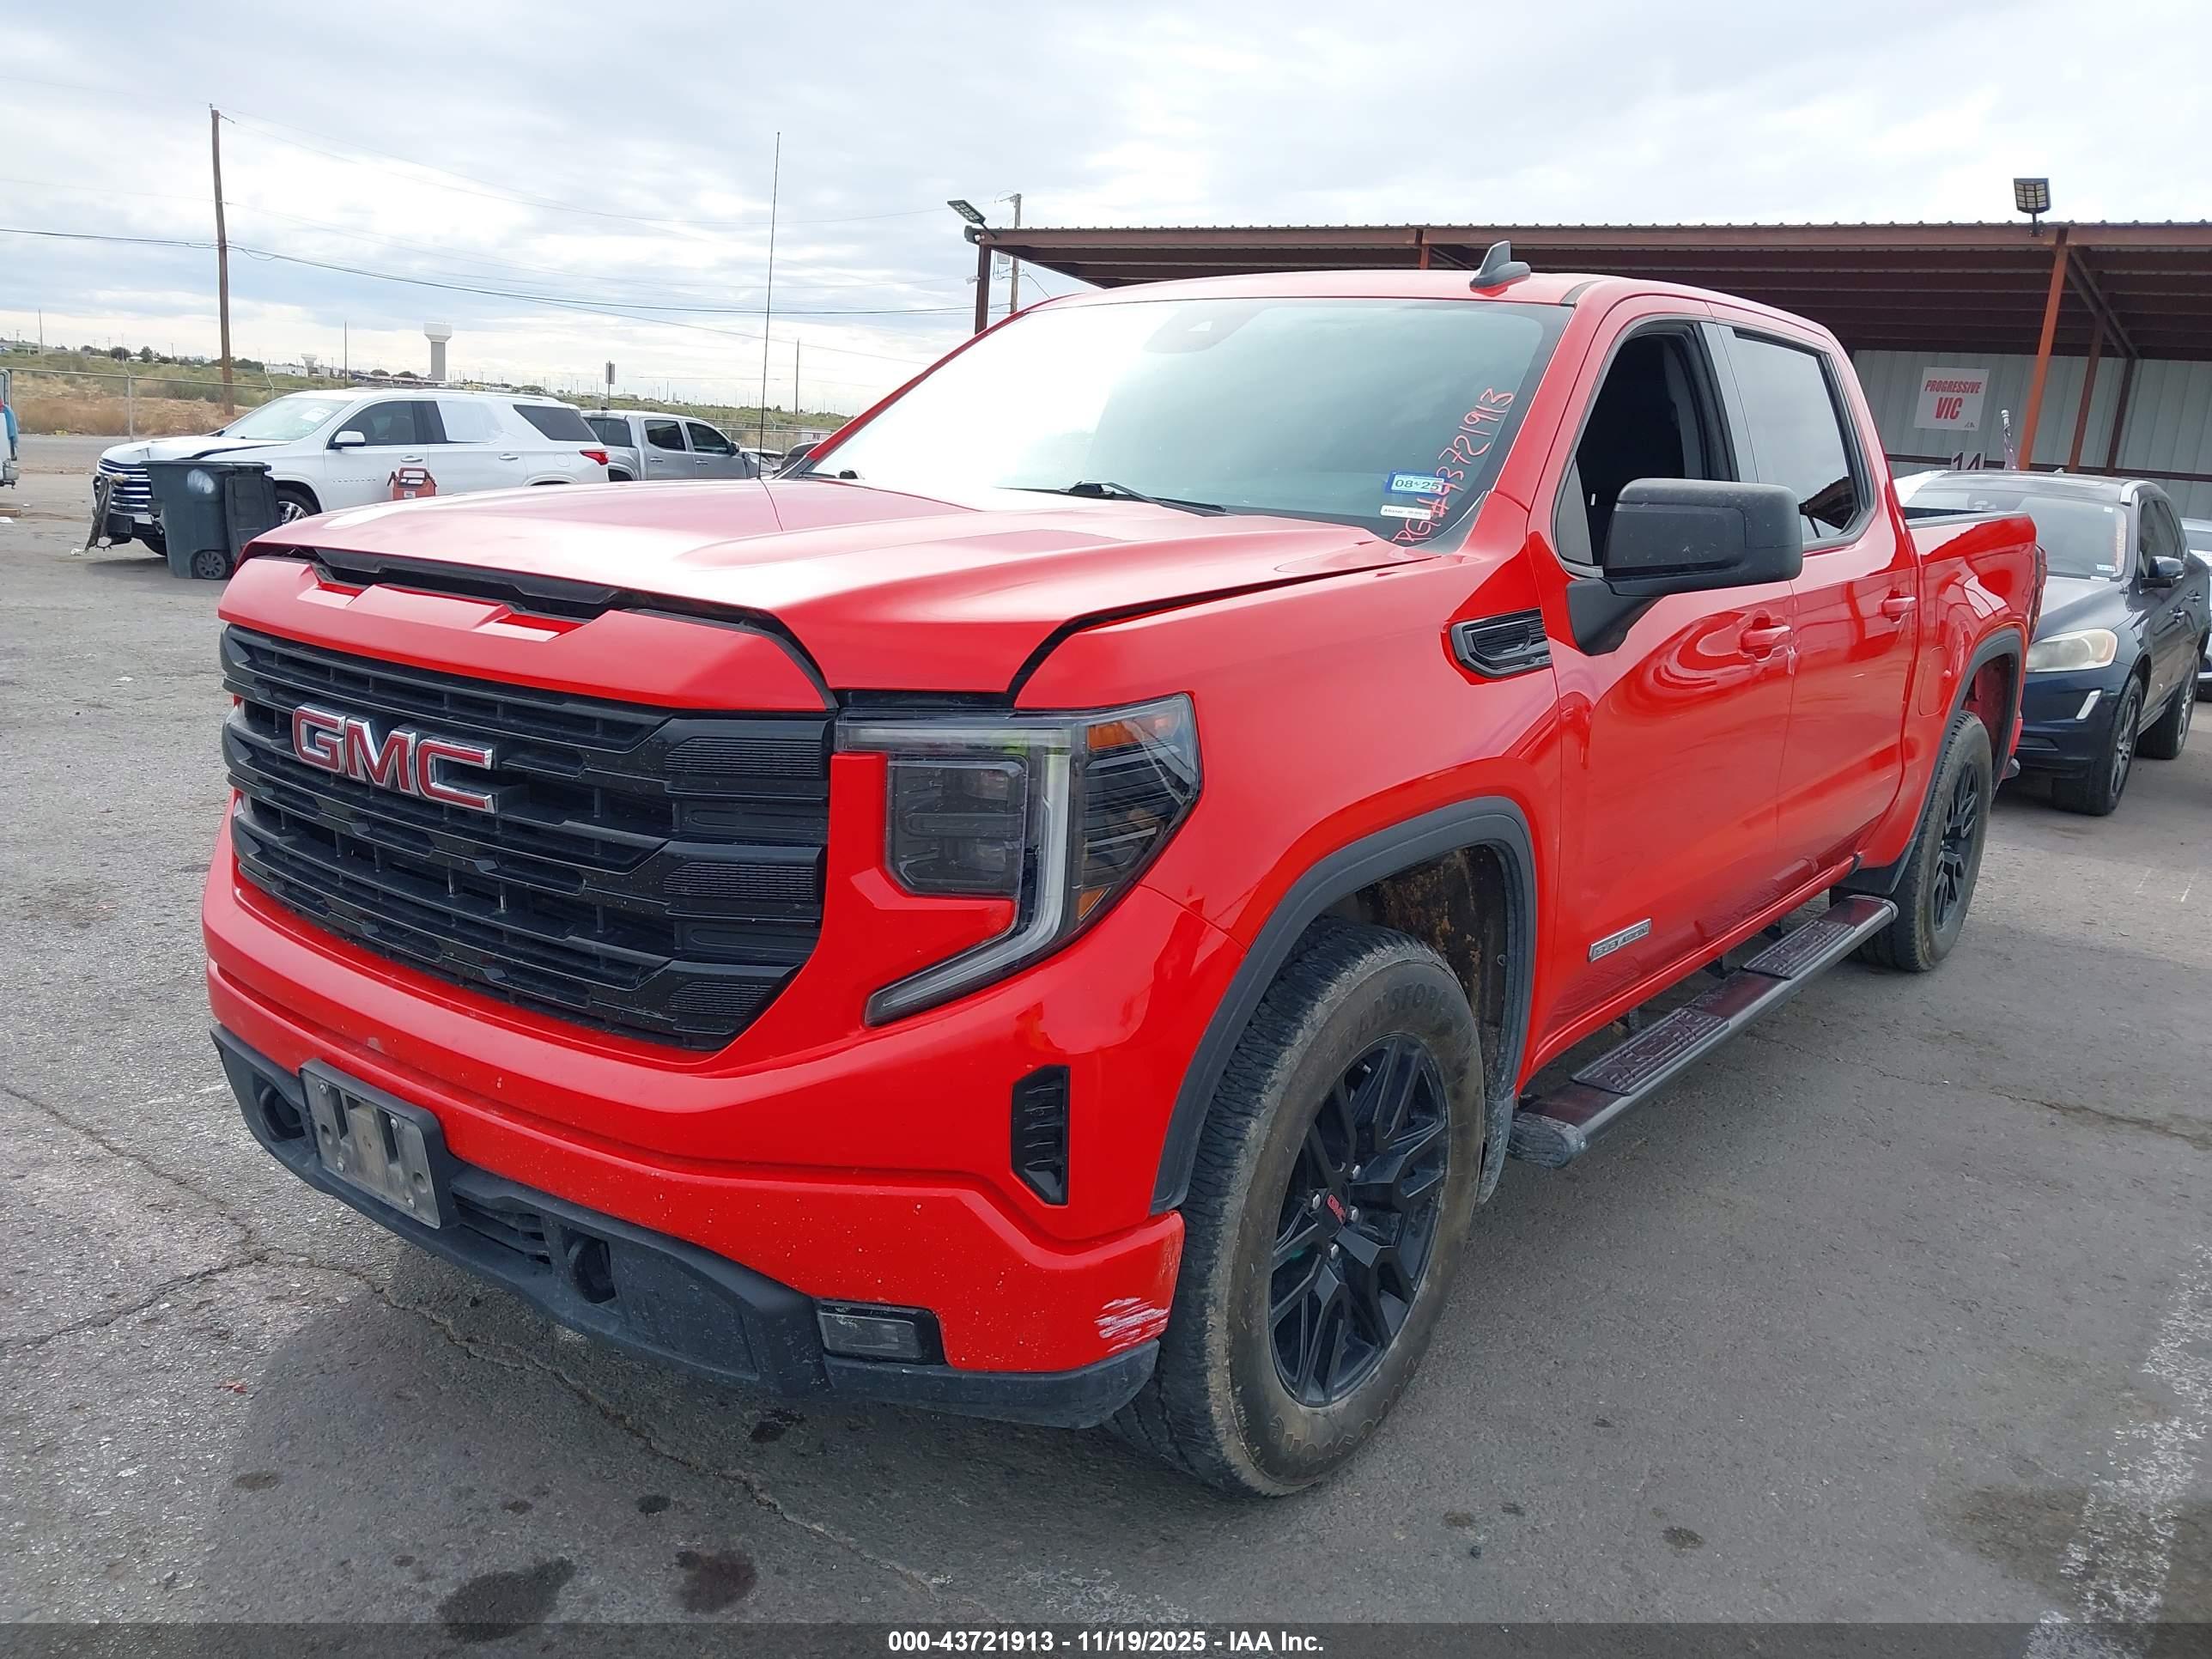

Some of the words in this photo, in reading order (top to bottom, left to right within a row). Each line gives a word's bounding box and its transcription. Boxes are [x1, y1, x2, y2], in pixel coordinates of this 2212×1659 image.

[1924, 380, 1982, 393] PROGRESSIVE
[1936, 397, 1963, 419] VIC
[1953, 452, 1982, 471] 14
[293, 706, 495, 814] GMC
